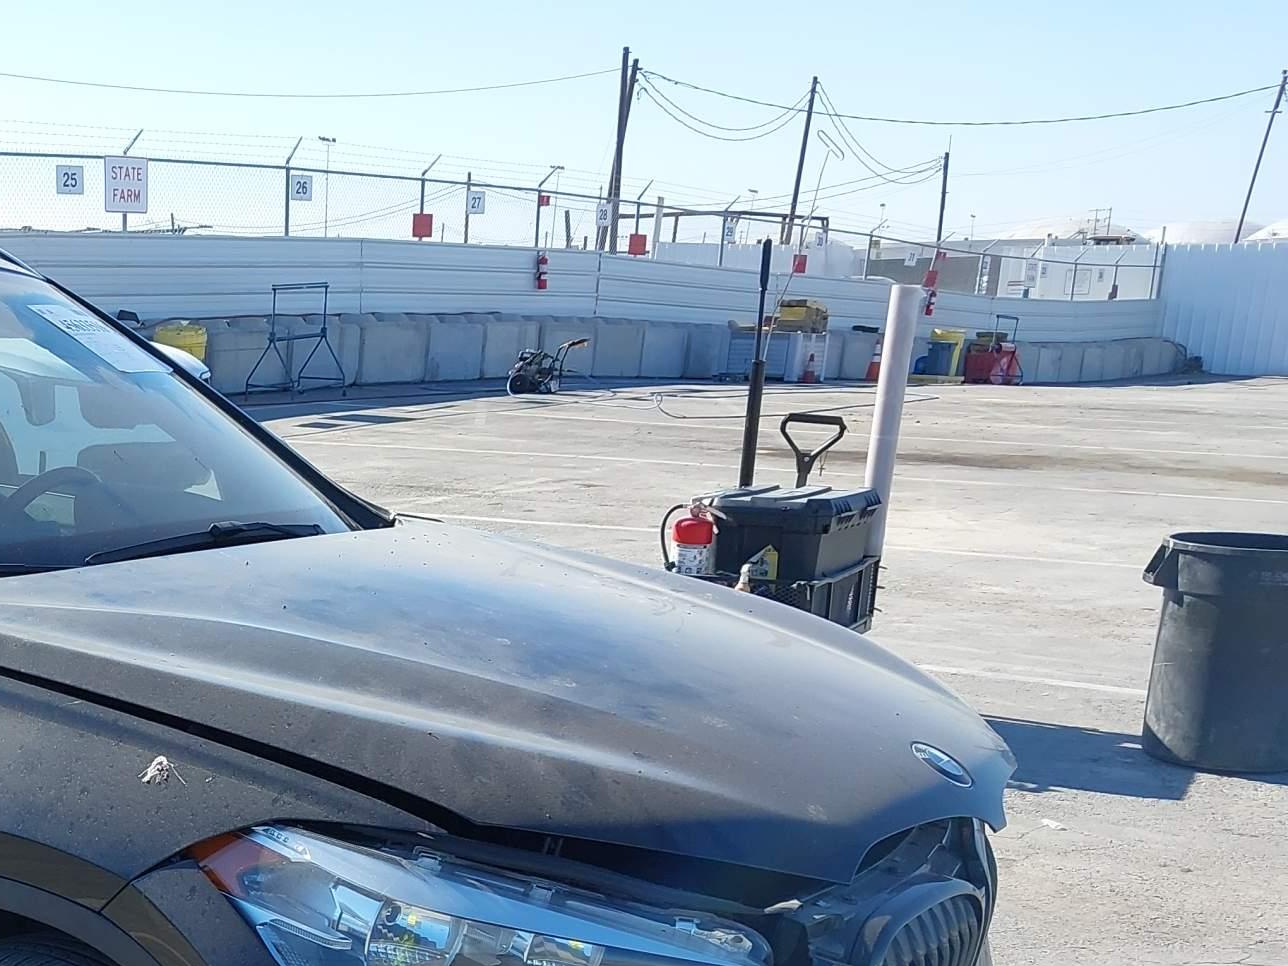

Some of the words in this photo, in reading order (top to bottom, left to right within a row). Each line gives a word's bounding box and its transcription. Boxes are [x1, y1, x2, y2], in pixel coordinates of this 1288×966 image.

[62, 172, 78, 188] 25
[111, 166, 143, 182] STATE
[296, 180, 308, 195] 26
[112, 188, 141, 204] FARM
[471, 197, 482, 209] 27
[599, 209, 608, 221] 28
